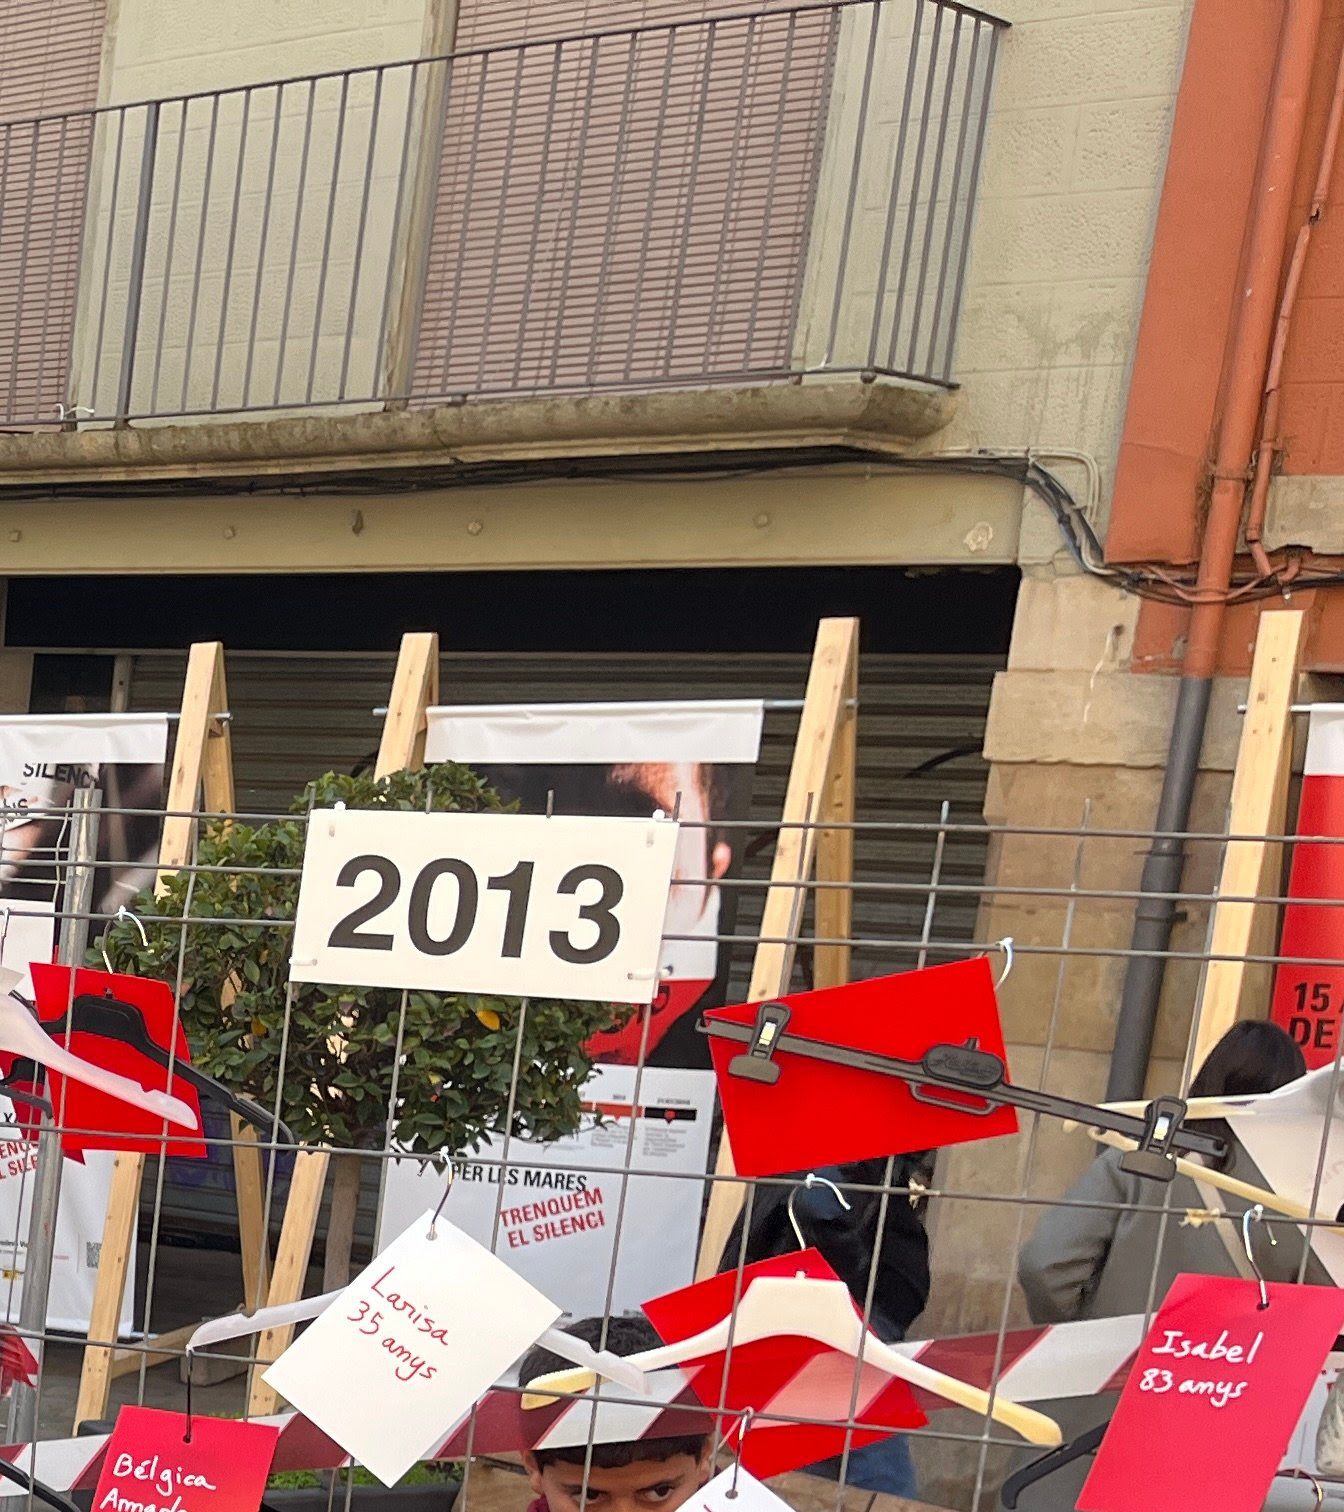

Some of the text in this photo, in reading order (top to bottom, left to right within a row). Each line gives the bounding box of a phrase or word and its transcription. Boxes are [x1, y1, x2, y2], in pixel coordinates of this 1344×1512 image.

[327, 854, 625, 965] 2013
[1293, 982, 1332, 1013] 15
[1288, 1016, 1336, 1049] DE
[499, 1186, 605, 1229] TRENQUEM
[507, 1210, 606, 1249] EL SILENCI
[369, 1266, 449, 1347] Larisa
[347, 1299, 438, 1385] 35 anys
[1151, 1328, 1265, 1365] Isabel
[1138, 1367, 1248, 1409] 83 anys
[112, 1452, 217, 1497] Bélgica
